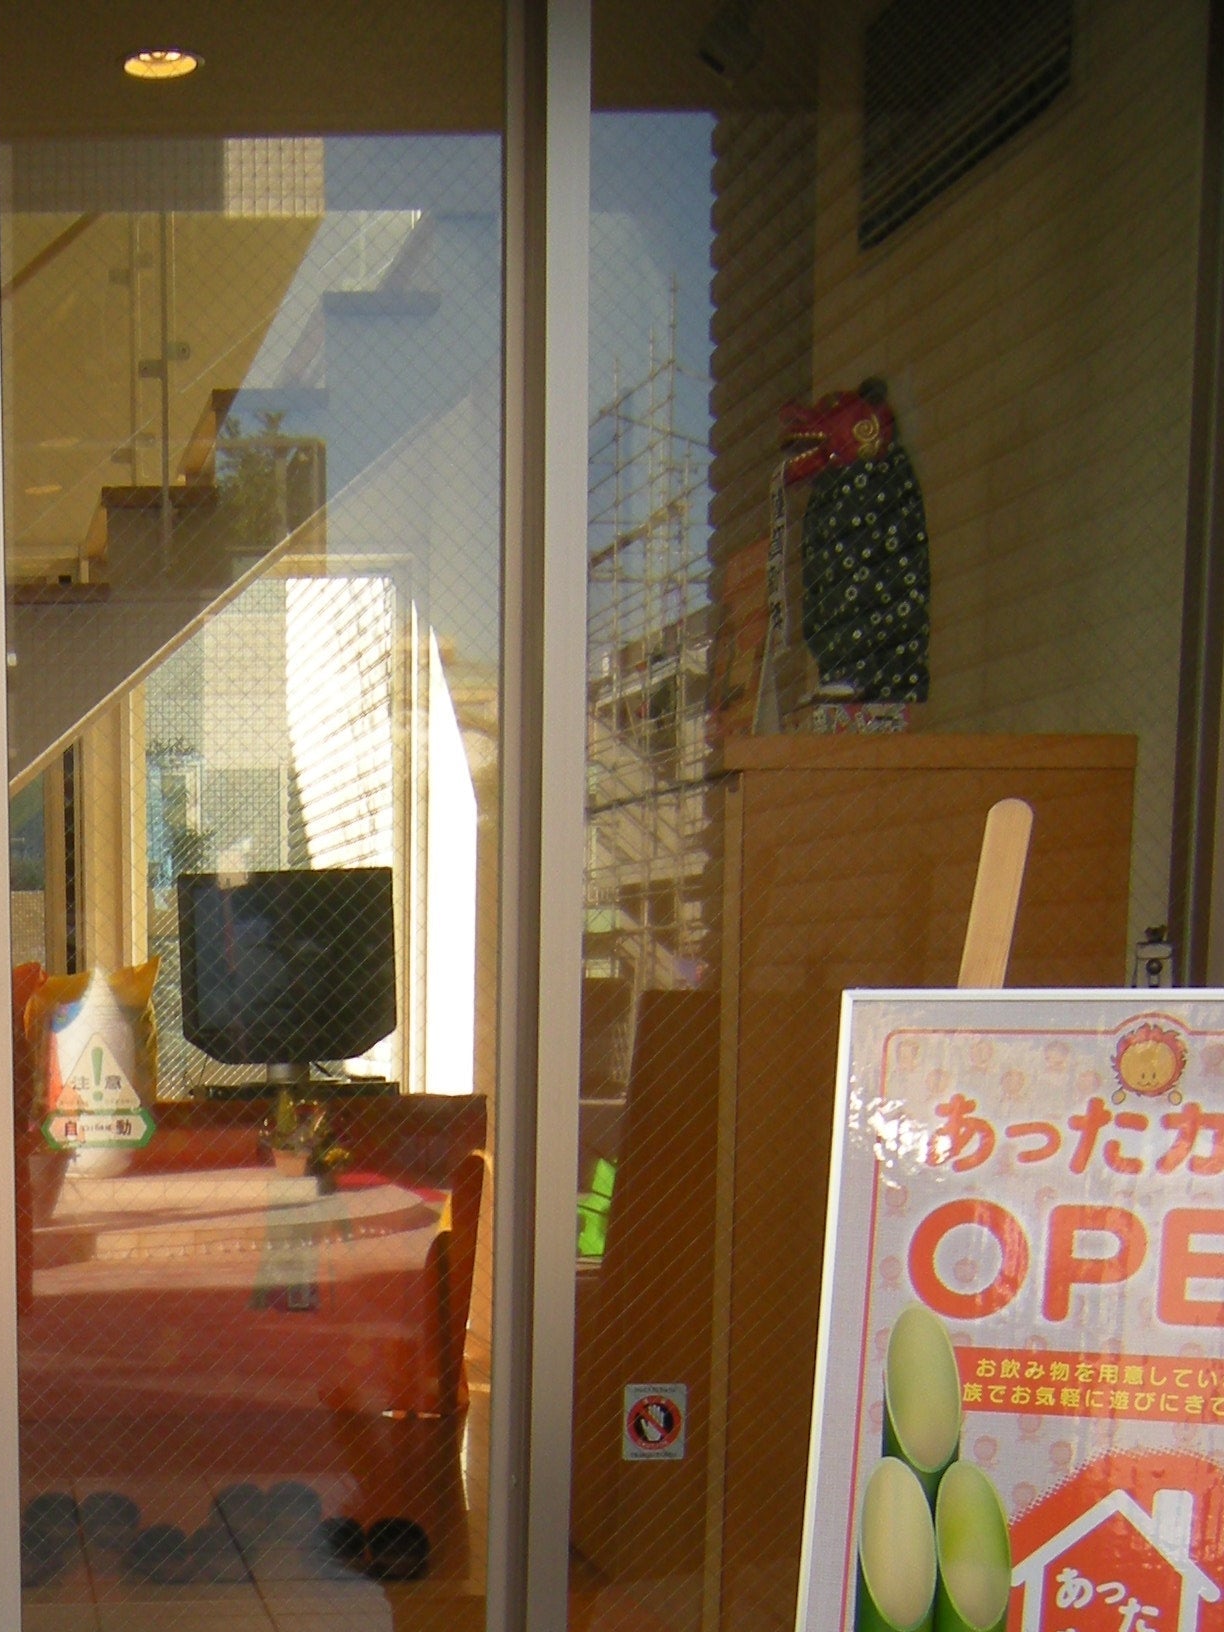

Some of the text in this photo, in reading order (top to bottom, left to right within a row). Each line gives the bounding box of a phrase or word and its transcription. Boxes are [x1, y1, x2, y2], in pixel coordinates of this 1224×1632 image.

[975, 1357, 1224, 1390] お飲み物を用意してい
